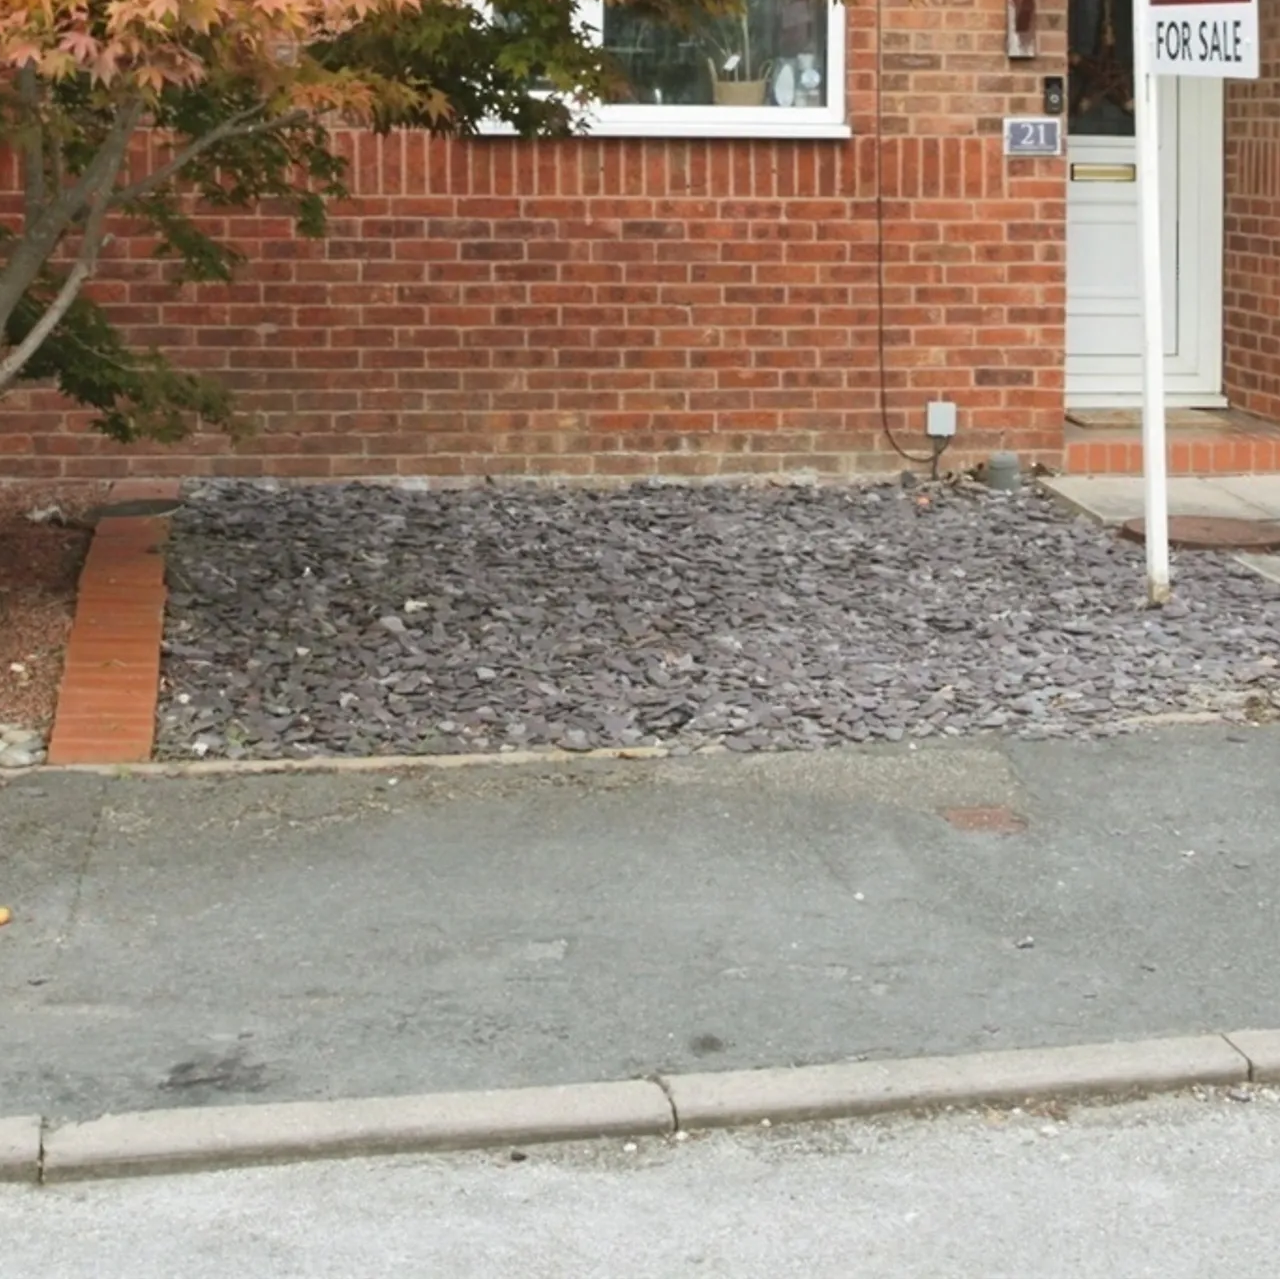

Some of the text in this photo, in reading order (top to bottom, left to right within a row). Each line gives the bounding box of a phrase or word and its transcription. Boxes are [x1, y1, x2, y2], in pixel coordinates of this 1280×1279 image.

[1156, 21, 1242, 63] FOR SALE
[1020, 123, 1046, 145] 21
